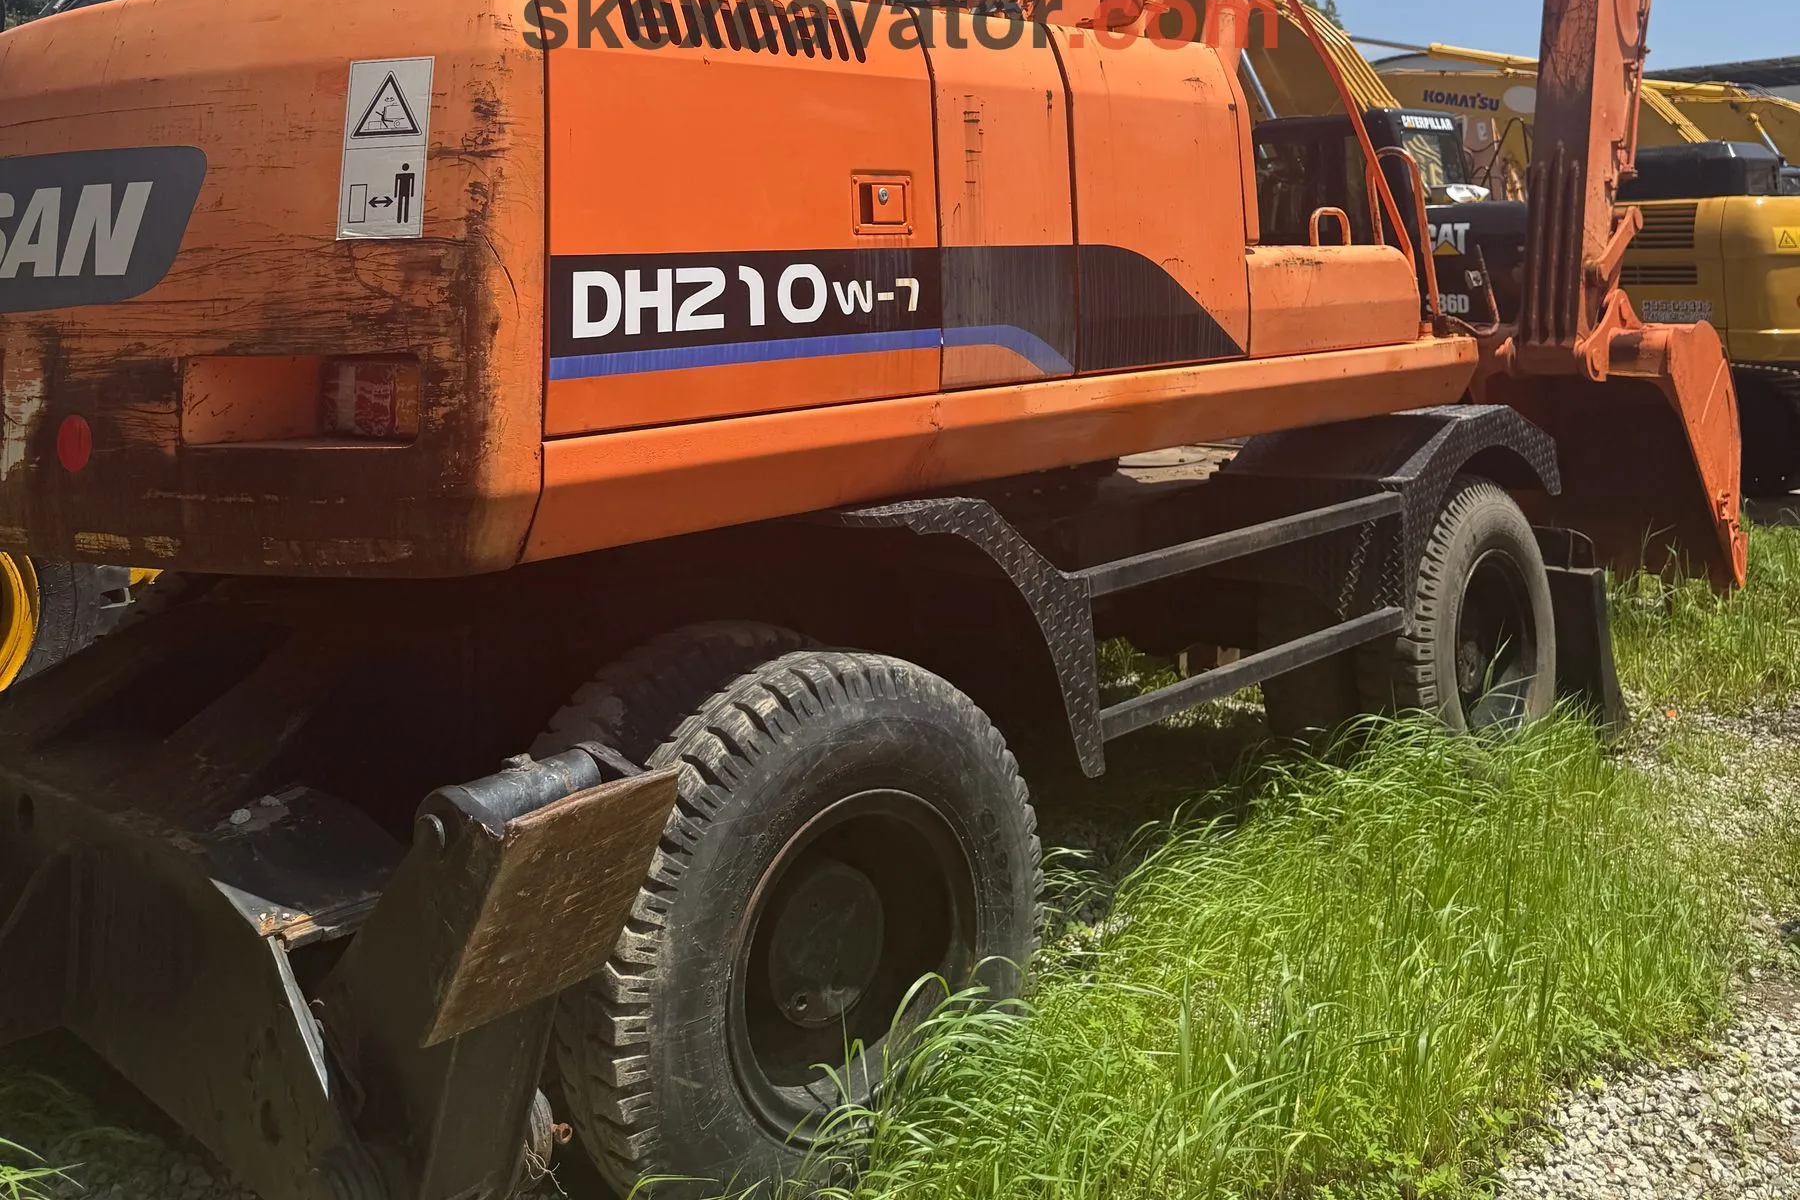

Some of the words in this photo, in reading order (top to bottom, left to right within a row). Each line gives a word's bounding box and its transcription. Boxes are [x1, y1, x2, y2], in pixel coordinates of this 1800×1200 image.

[1423, 89, 1499, 112] KOMATSU
[1401, 115, 1454, 131] CATERPILLAR
[1427, 222, 1470, 255] CAT
